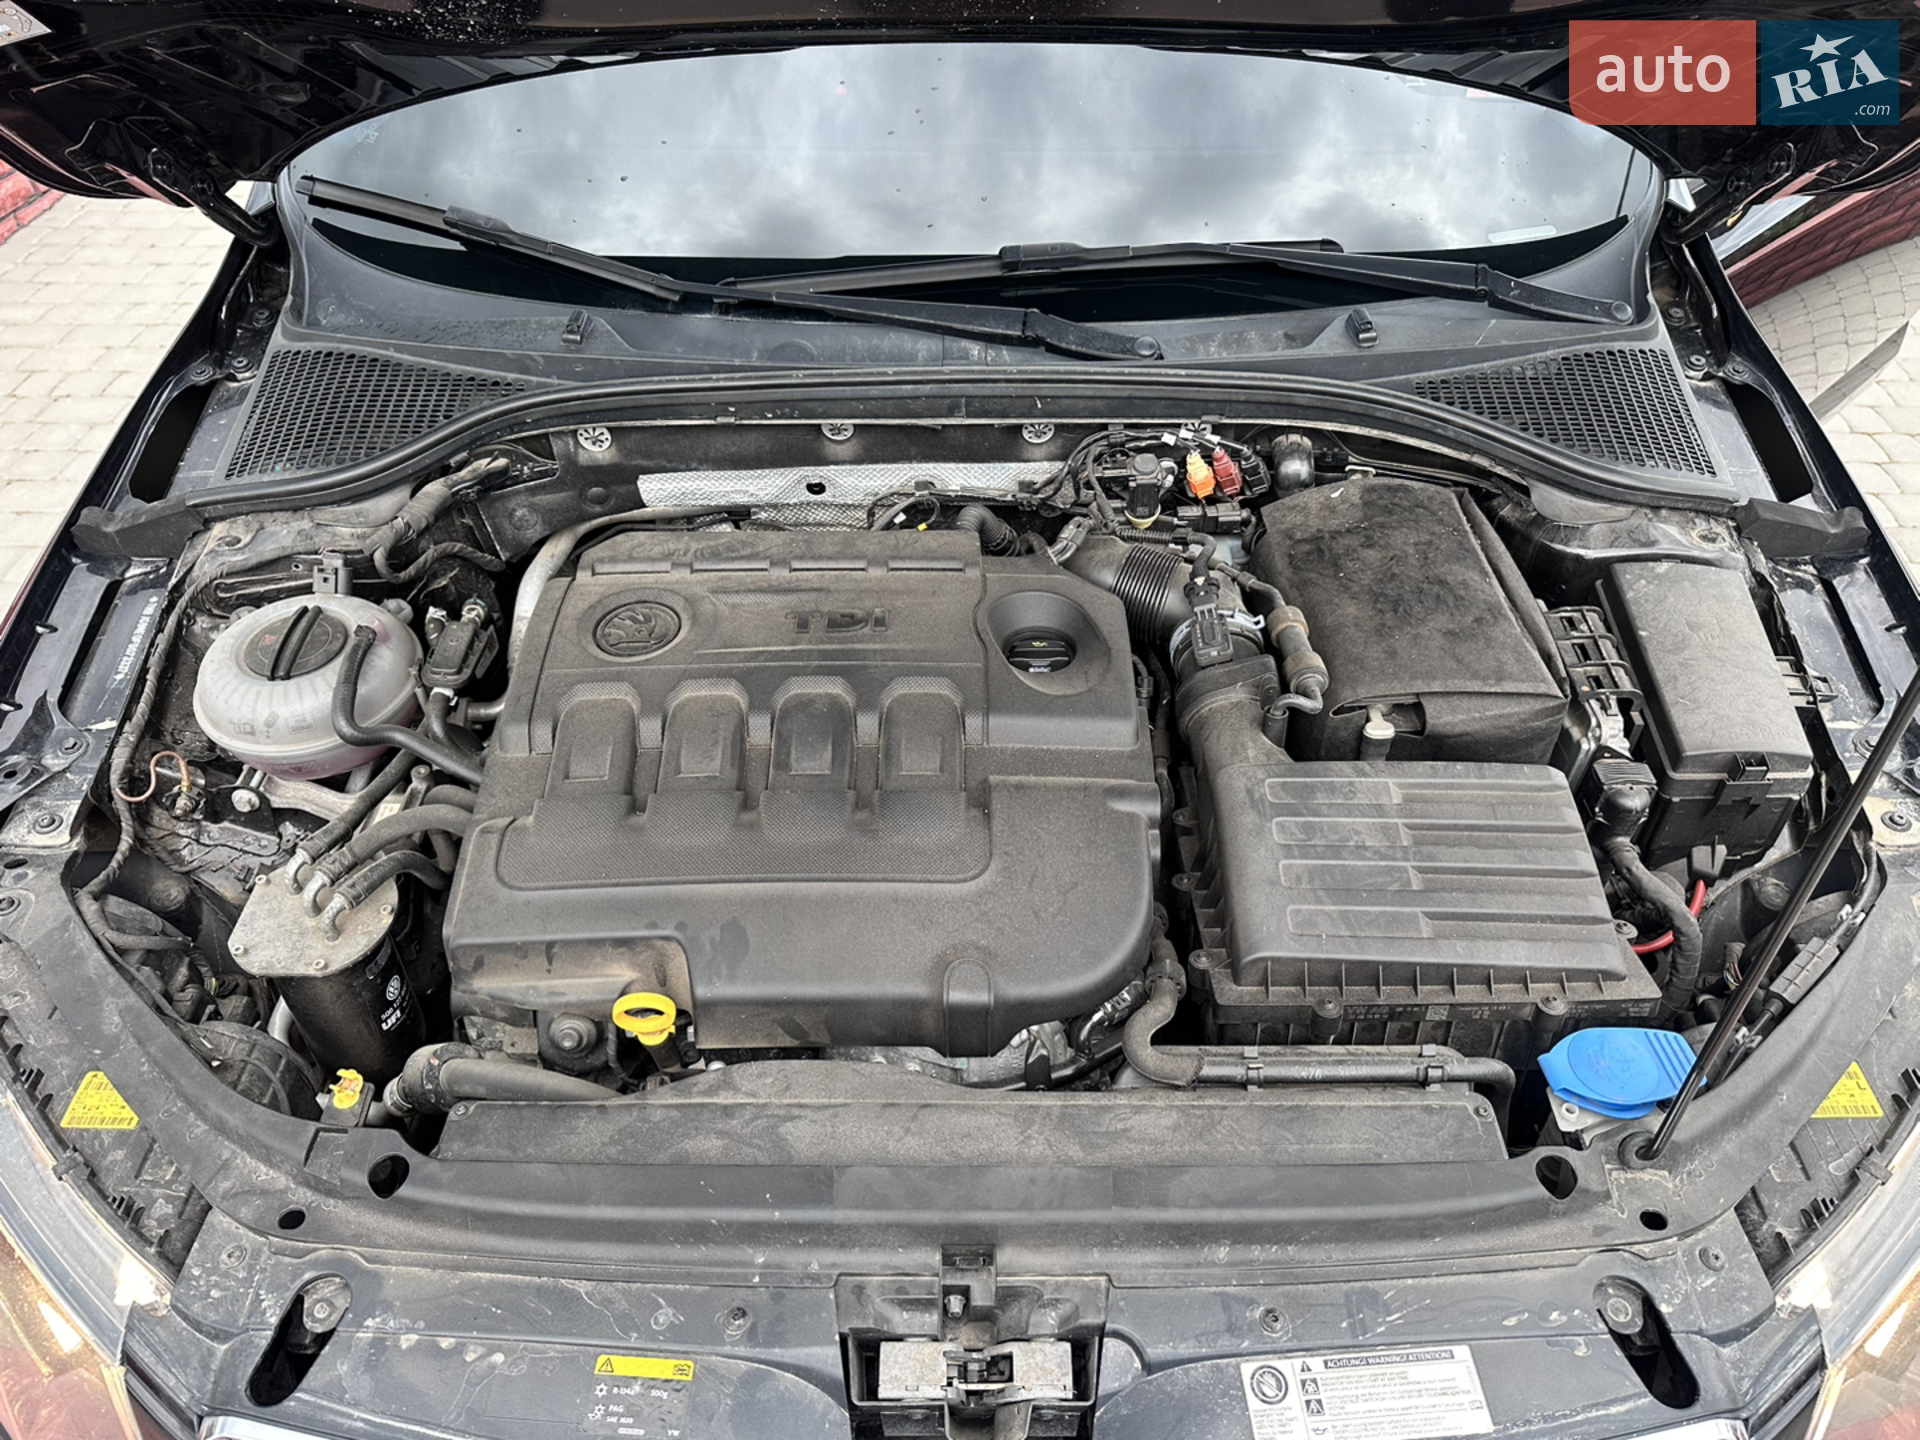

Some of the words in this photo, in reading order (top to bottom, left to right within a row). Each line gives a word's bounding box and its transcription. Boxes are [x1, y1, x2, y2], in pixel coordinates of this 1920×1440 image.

[785, 608, 888, 634] TDI
[1326, 1357, 1367, 1368] ACHTUNG!
[1367, 1354, 1407, 1364] WARNING!
[1408, 1350, 1452, 1361] ATTENTION!
[608, 1404, 624, 1413] PAG
